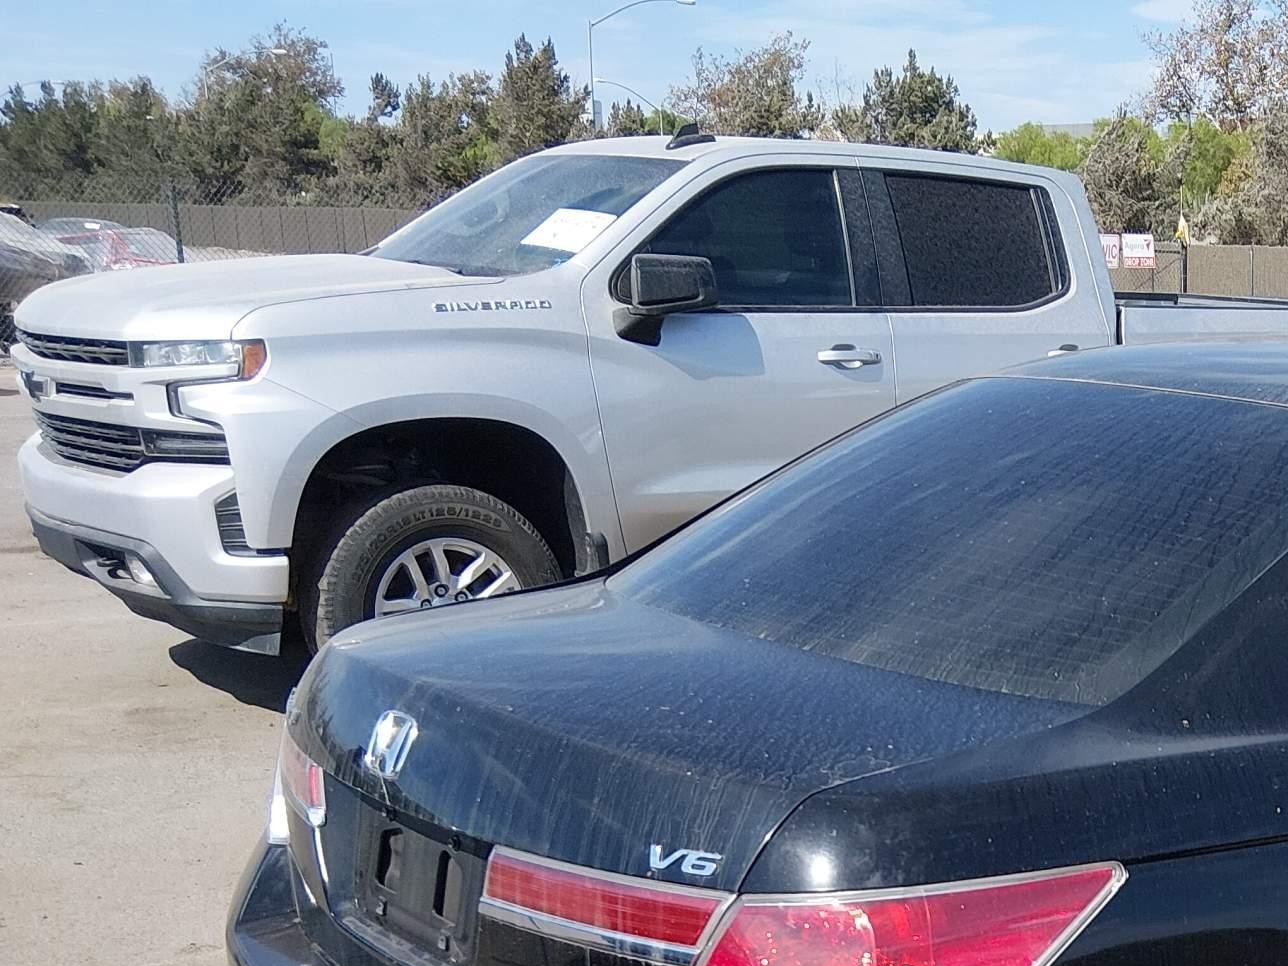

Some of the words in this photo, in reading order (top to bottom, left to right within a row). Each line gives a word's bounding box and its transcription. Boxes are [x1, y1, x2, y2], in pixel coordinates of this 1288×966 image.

[1125, 258, 1139, 267] DROP
[1140, 258, 1154, 267] ZONE
[434, 300, 552, 313] SILVERADO
[650, 844, 722, 876] V6
